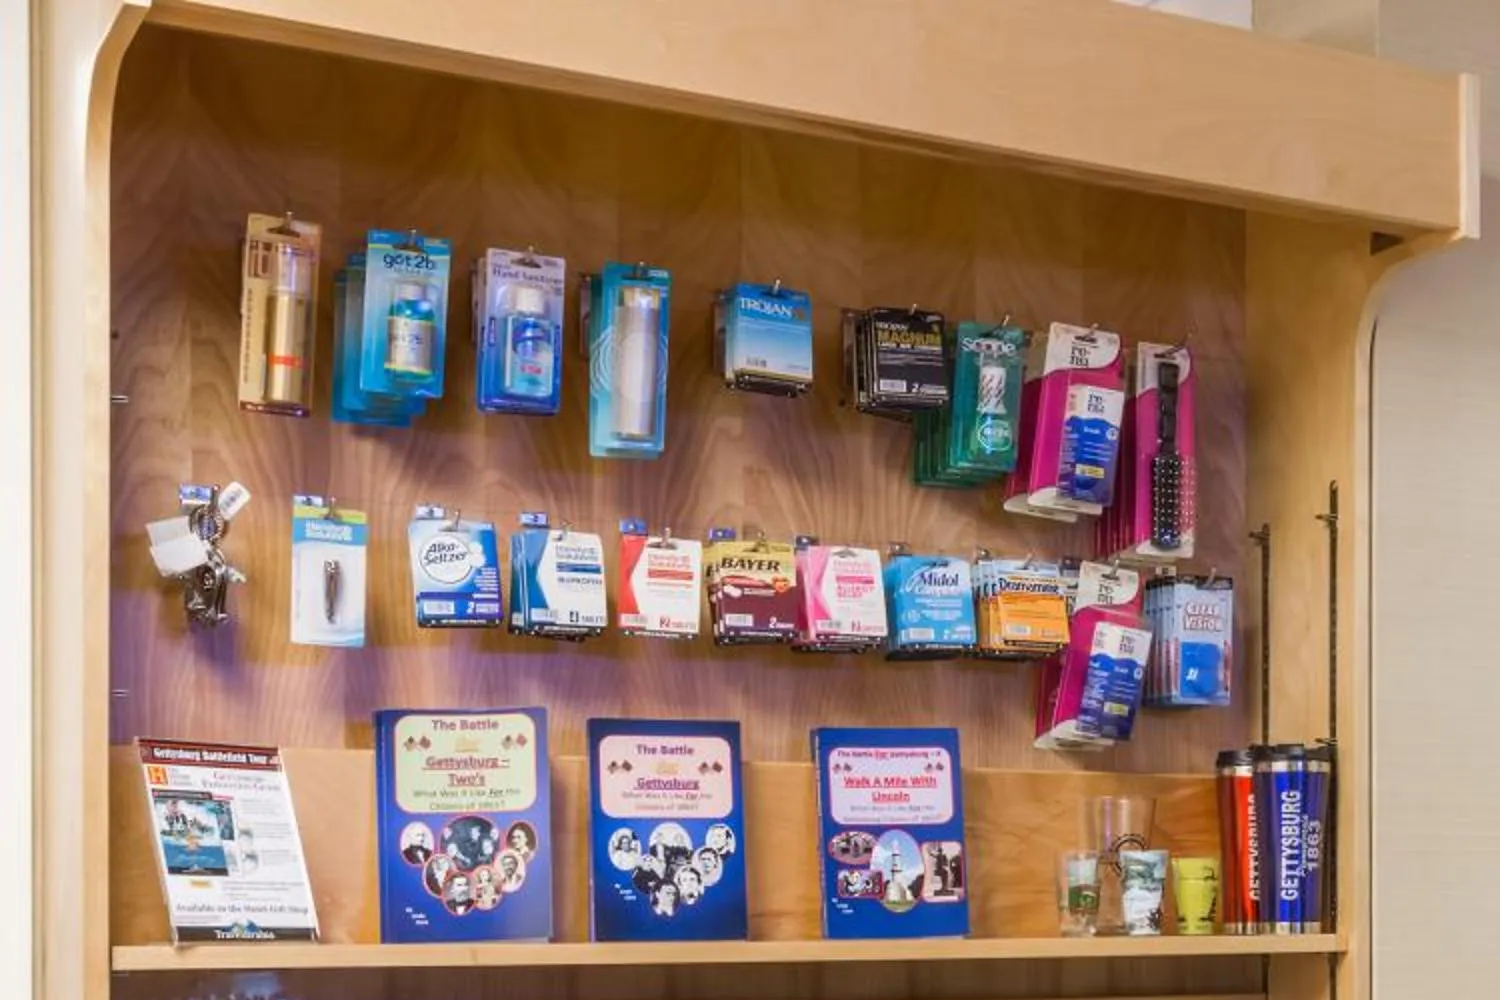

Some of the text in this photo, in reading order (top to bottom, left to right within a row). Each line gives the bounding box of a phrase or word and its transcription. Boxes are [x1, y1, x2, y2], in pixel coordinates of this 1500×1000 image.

[383, 252, 437, 270] got2b
[739, 296, 793, 318] TROJAN
[962, 336, 1017, 357] Scope
[720, 557, 781, 573] BAYER
[920, 571, 960, 587] Midol
[432, 718, 499, 731] The Battle
[636, 743, 695, 756] The Battle
[636, 777, 700, 791] Gettysburg
[843, 775, 937, 788] Walk A Mile With
[871, 791, 911, 803] Lincoln
[1281, 789, 1301, 901] GETTYSBURG
[1307, 820, 1321, 872] 1863
